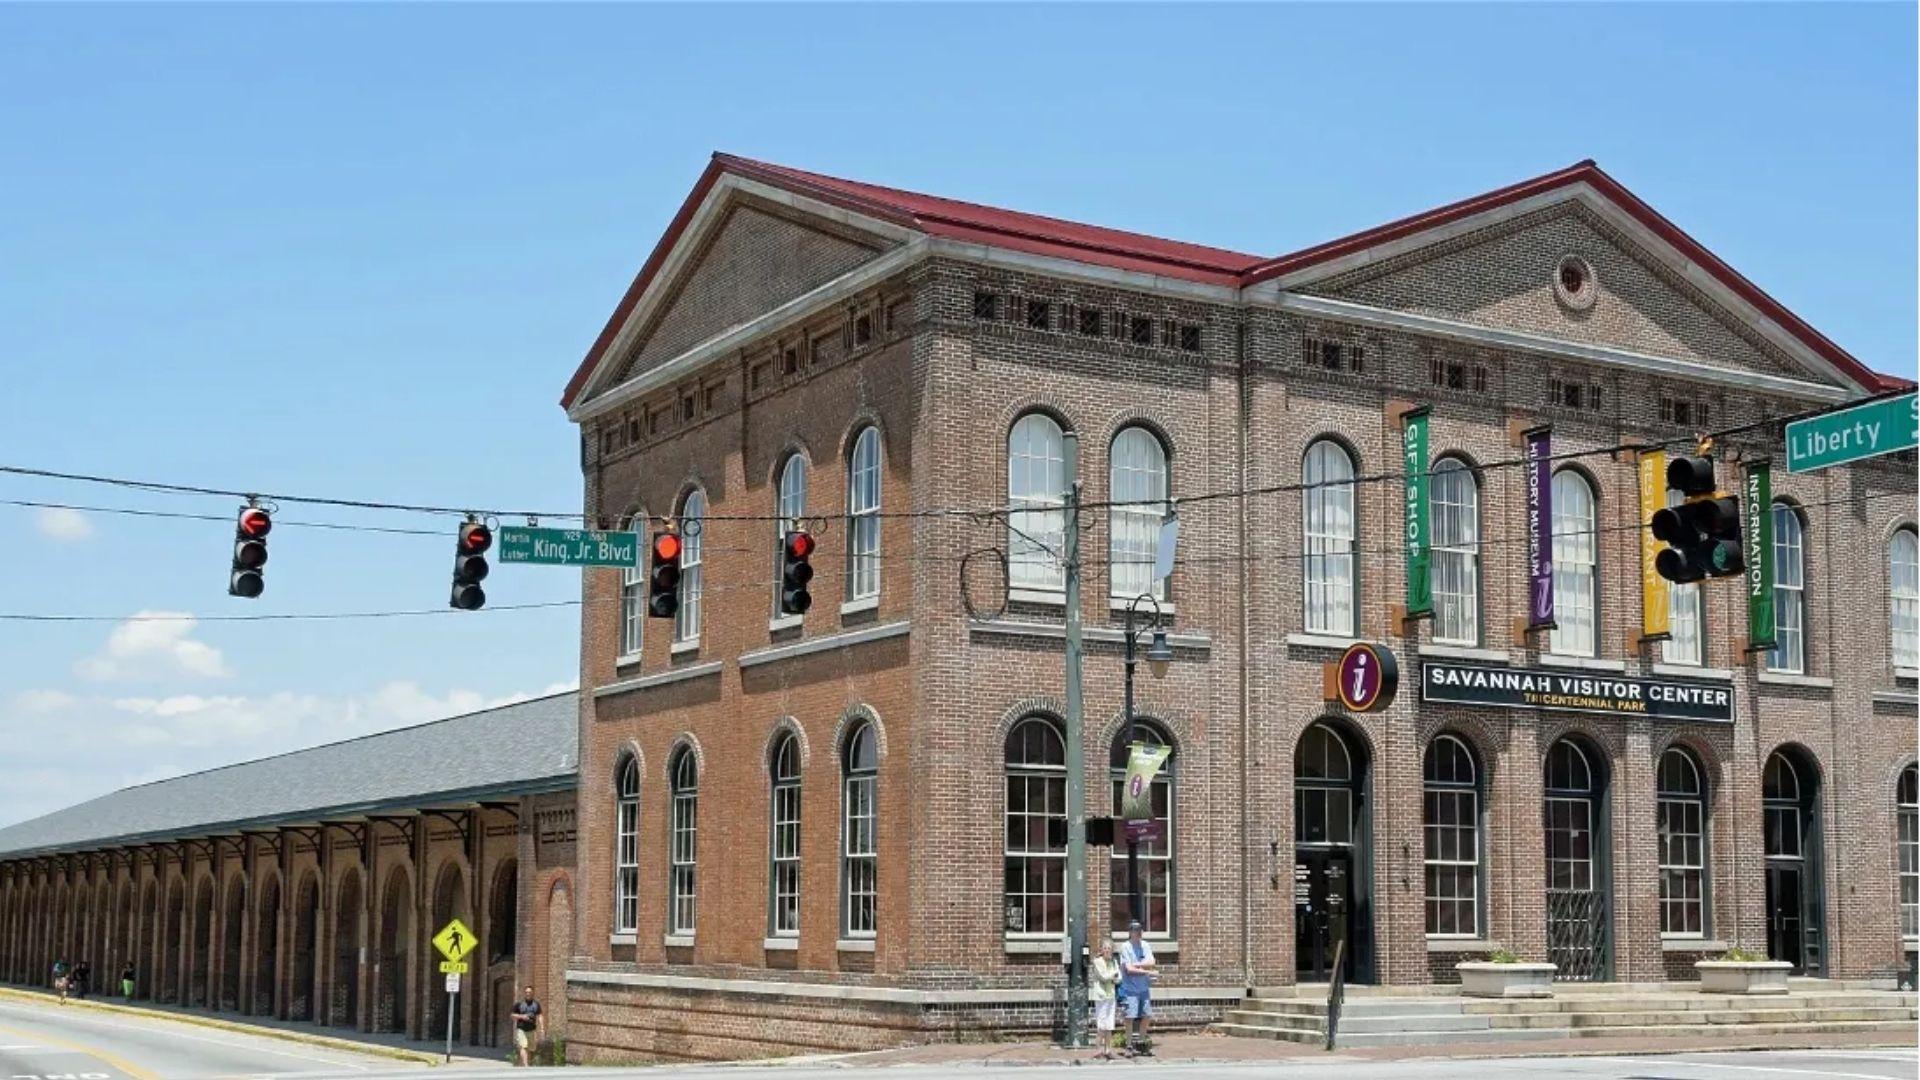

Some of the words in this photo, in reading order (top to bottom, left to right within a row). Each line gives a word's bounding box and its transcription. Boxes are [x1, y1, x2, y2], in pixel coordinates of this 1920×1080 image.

[1791, 421, 1881, 460] Liberty
[1530, 441, 1539, 506] HISTORY
[503, 533, 530, 543] Martin
[1407, 485, 1419, 557] SHOP
[1749, 473, 1761, 597] INFORMATION
[502, 549, 530, 561] Luther
[574, 540, 593, 559] Jr.
[598, 542, 633, 561] Blvd.
[1530, 509, 1540, 577] MUSEUM
[1432, 668, 1551, 692] SAVANNAH
[1560, 679, 1641, 699] VISITOR
[1649, 685, 1728, 706] CENTER
[1523, 692, 1614, 708] TRICENTENNIAL
[1618, 700, 1646, 711] PARK
